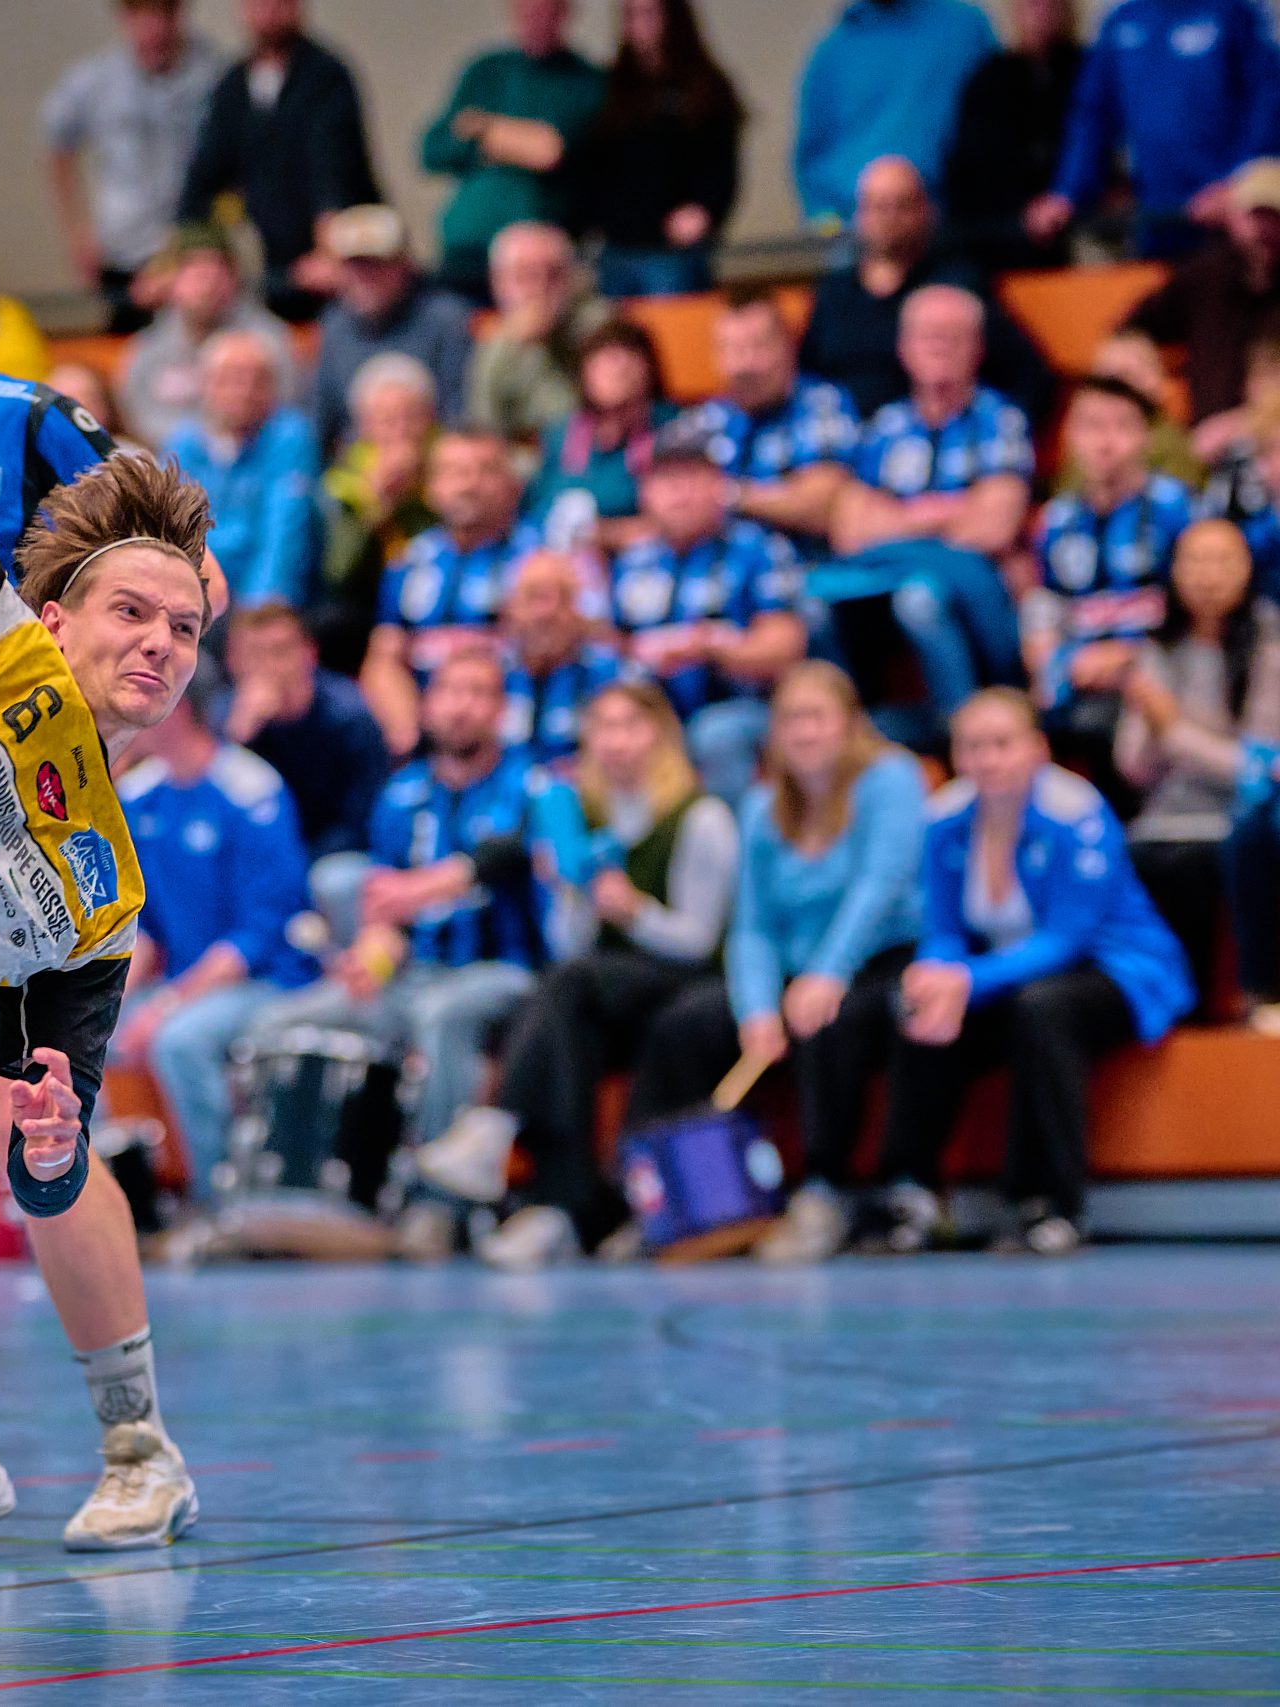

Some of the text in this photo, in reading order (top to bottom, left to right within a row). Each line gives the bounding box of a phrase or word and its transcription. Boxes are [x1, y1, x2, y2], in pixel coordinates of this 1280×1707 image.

[2, 684, 63, 744] 6
[40, 777, 60, 811] TVK
[28, 866, 72, 943] GEISSER
